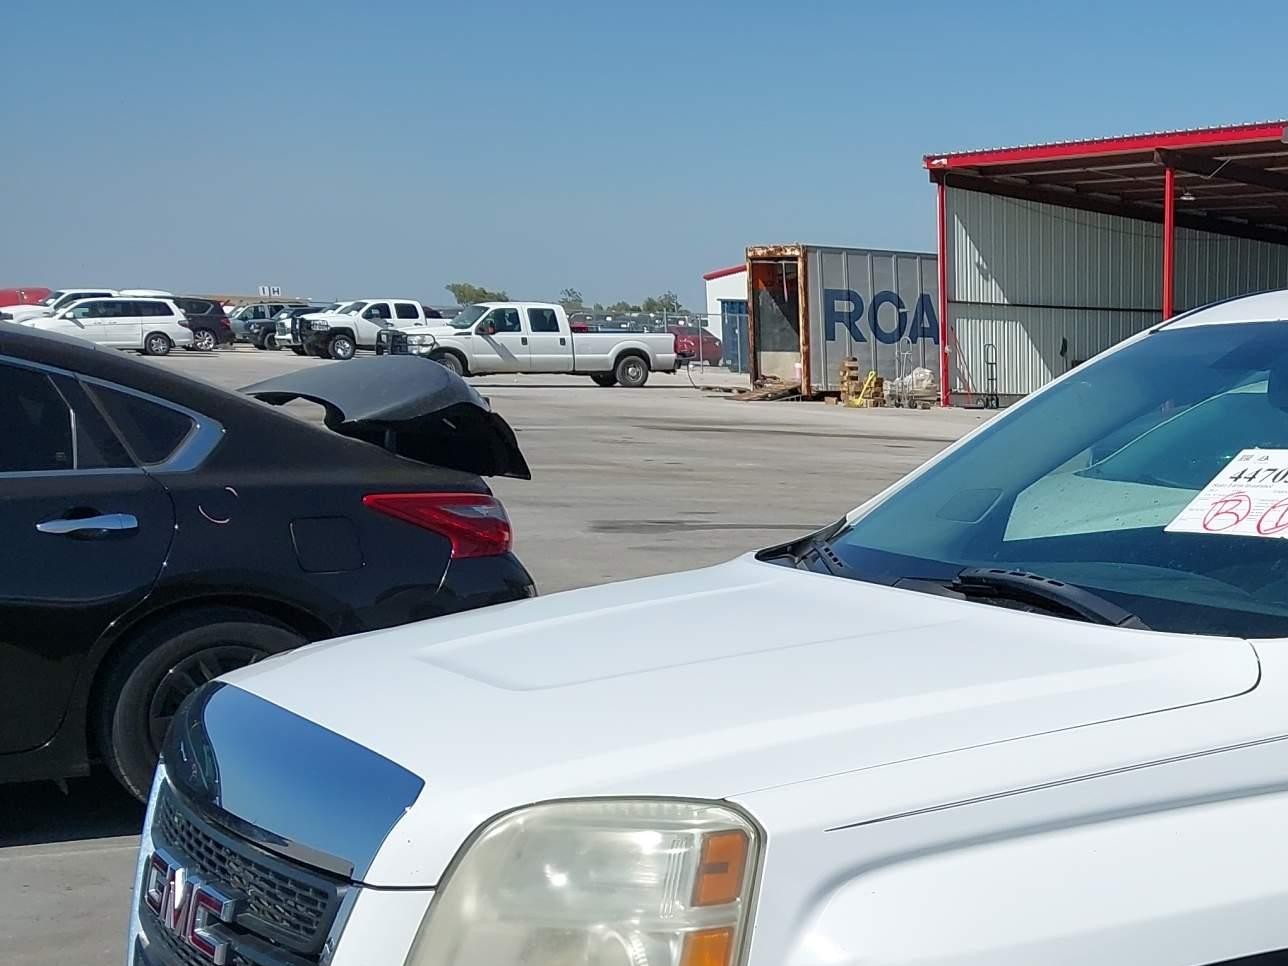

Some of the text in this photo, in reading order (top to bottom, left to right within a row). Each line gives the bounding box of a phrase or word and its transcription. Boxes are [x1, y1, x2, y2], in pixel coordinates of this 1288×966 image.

[824, 288, 939, 345] ROA
[1203, 493, 1248, 532] B
[144, 848, 235, 966] GMC
